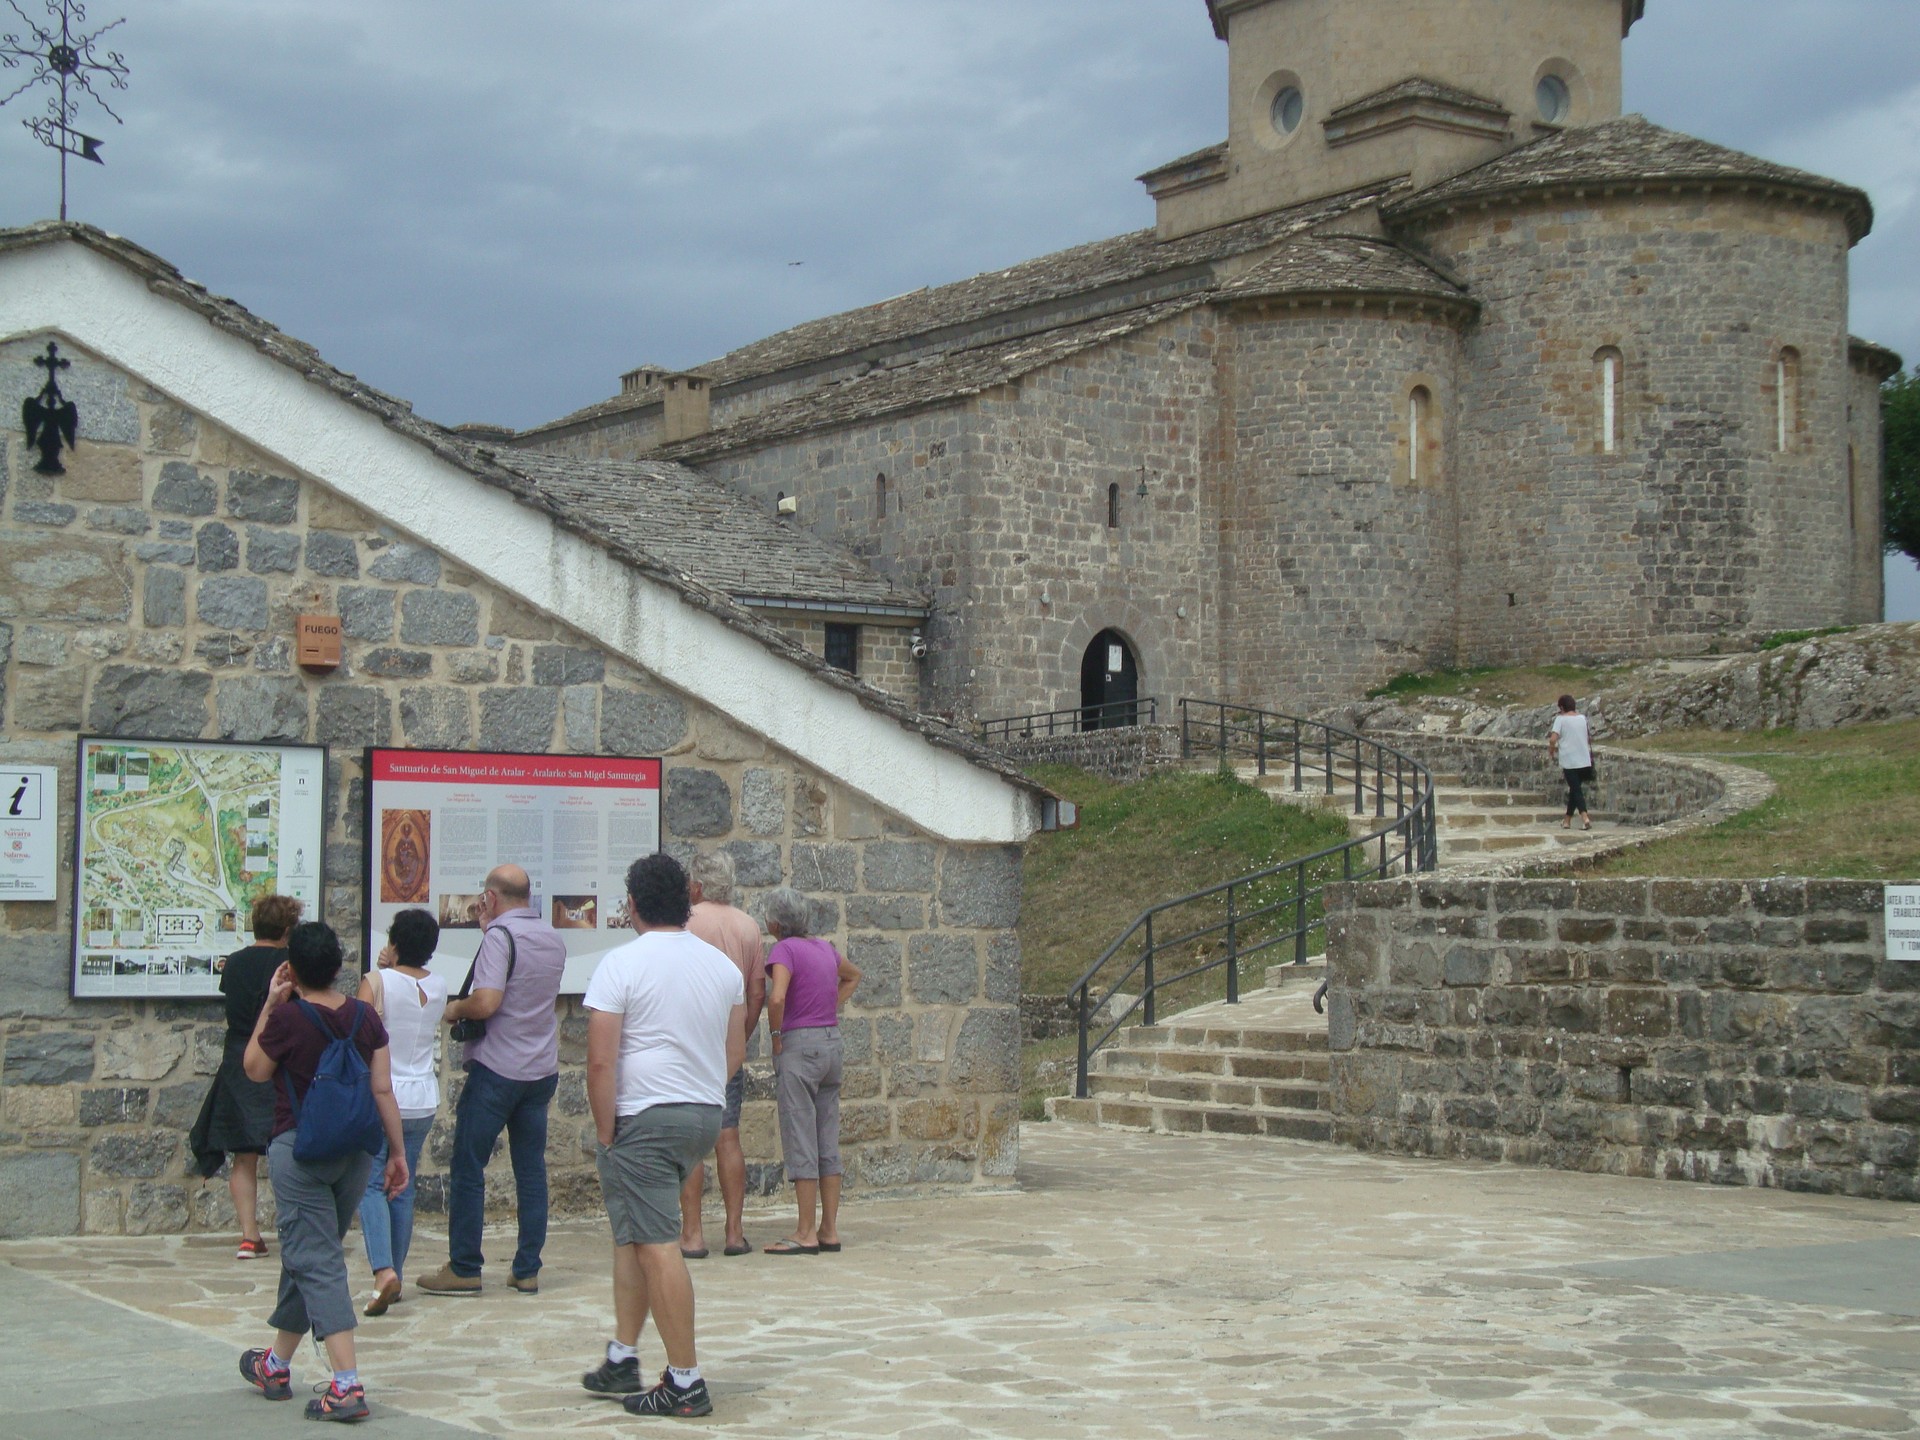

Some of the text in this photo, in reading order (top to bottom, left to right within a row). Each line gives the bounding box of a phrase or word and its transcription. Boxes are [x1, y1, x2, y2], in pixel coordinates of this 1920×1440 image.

[304, 625, 338, 635] FUEGO
[389, 763, 429, 774] Santuario
[430, 764, 441, 774] de
[442, 765, 457, 775] San
[459, 765, 487, 777] Miguel
[489, 766, 499, 776] de
[501, 766, 525, 777] Aralar
[532, 767, 566, 778] Aralarko
[568, 768, 582, 778] San
[584, 769, 605, 781] Migel
[607, 770, 646, 782] Santutegia
[1905, 896, 1915, 905] ETA
